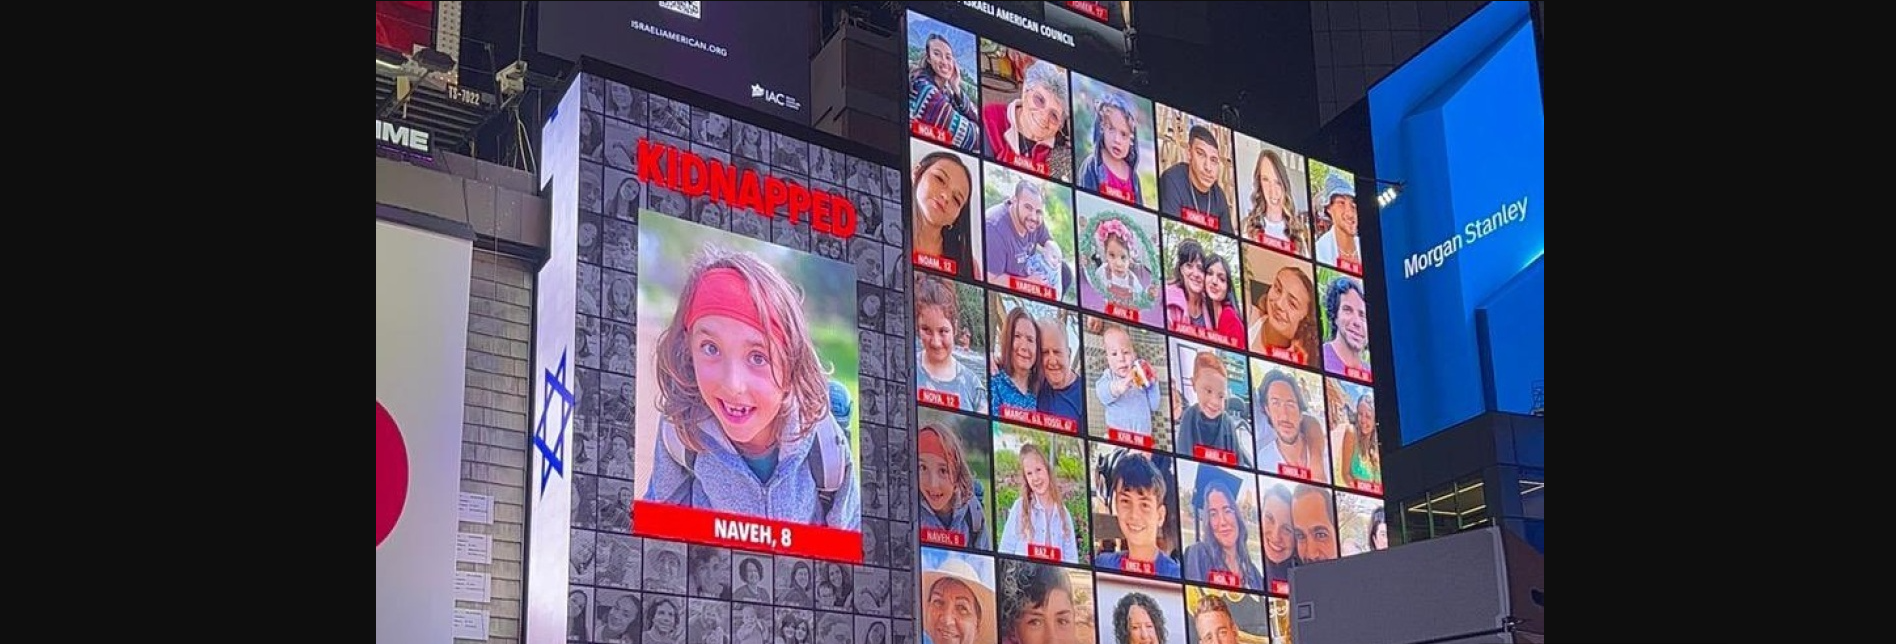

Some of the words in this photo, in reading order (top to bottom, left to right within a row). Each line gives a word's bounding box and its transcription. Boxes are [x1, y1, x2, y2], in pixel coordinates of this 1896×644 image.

[631, 20, 728, 57] ISRAELIAMERICAN.ORG
[996, 9, 1039, 33] AMERICAN
[1040, 25, 1075, 47] COUNCIL
[765, 89, 785, 106] IAC
[637, 135, 857, 239] KIDNAPPED
[1404, 234, 1463, 279] Morgan
[1464, 196, 1528, 244] Stanley
[714, 519, 777, 547] NAVEH,
[781, 528, 792, 547] 8
[927, 532, 953, 545] NAVEH,
